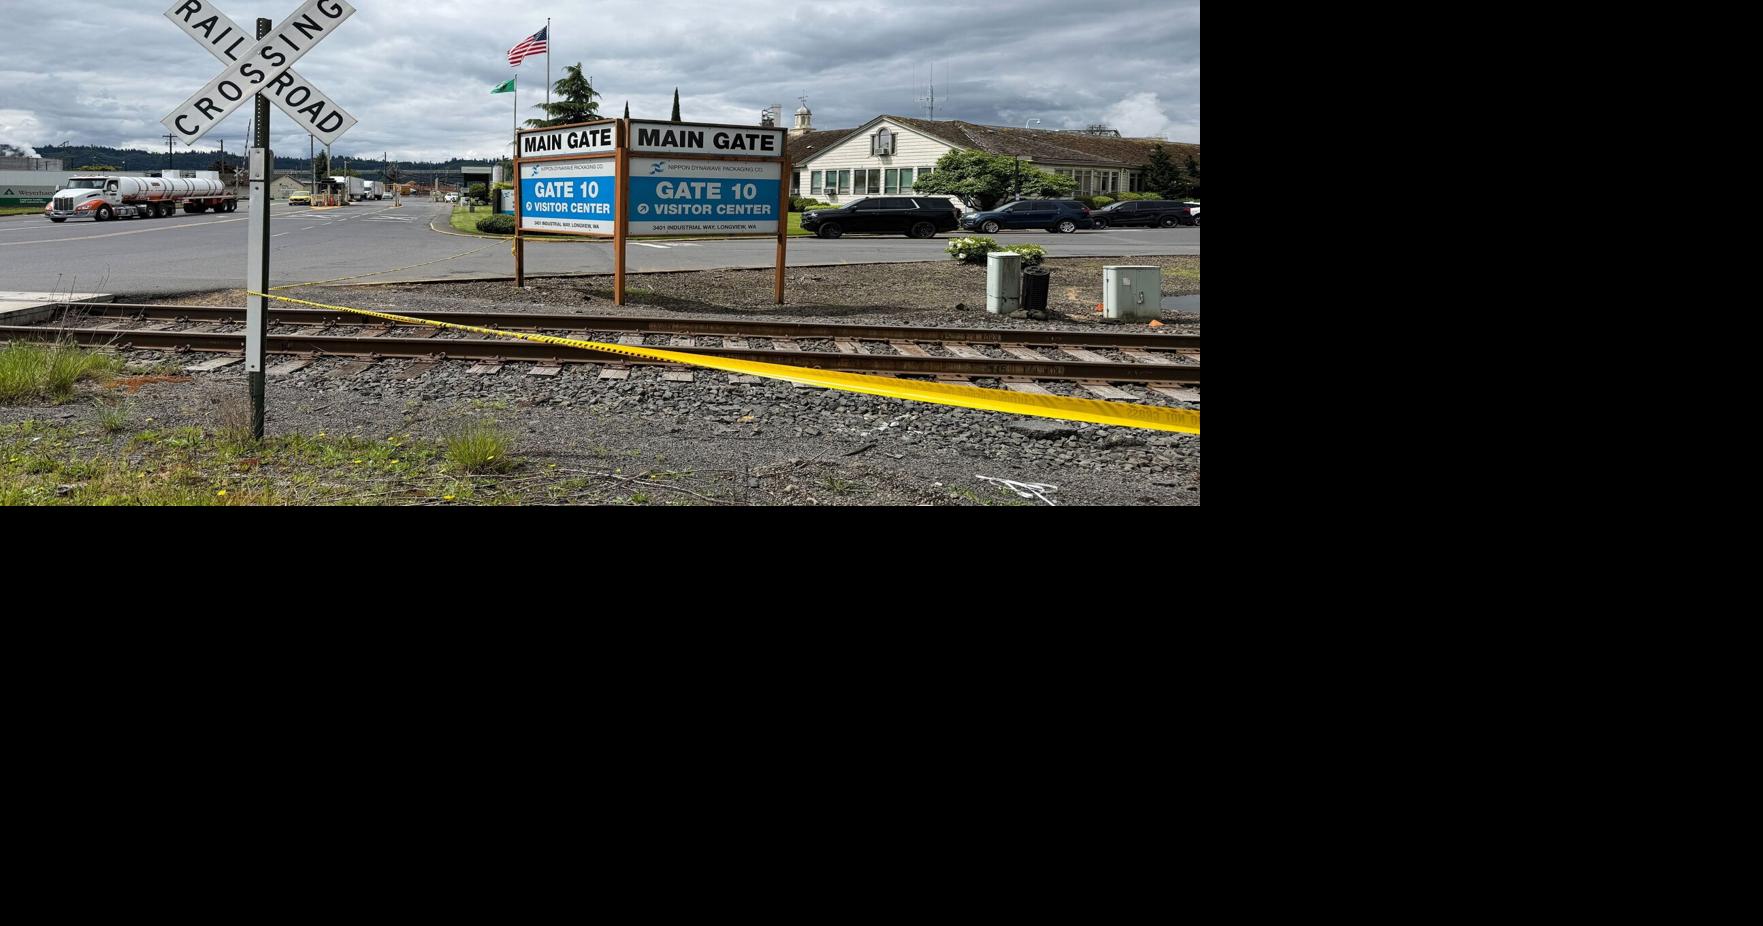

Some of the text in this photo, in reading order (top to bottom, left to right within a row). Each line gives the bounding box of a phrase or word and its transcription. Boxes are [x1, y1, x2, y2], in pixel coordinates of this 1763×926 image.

[174, 0, 344, 133] RAIL ROAD
[174, 0, 344, 136] CROSSING
[525, 129, 611, 152] MAIN GATE
[638, 129, 774, 151] MAIN GATE
[534, 181, 599, 198] GATE 10
[656, 181, 757, 200] GATE 10
[534, 202, 610, 214] VISITOR CENTER
[654, 204, 771, 215] VISITOR CENTER
